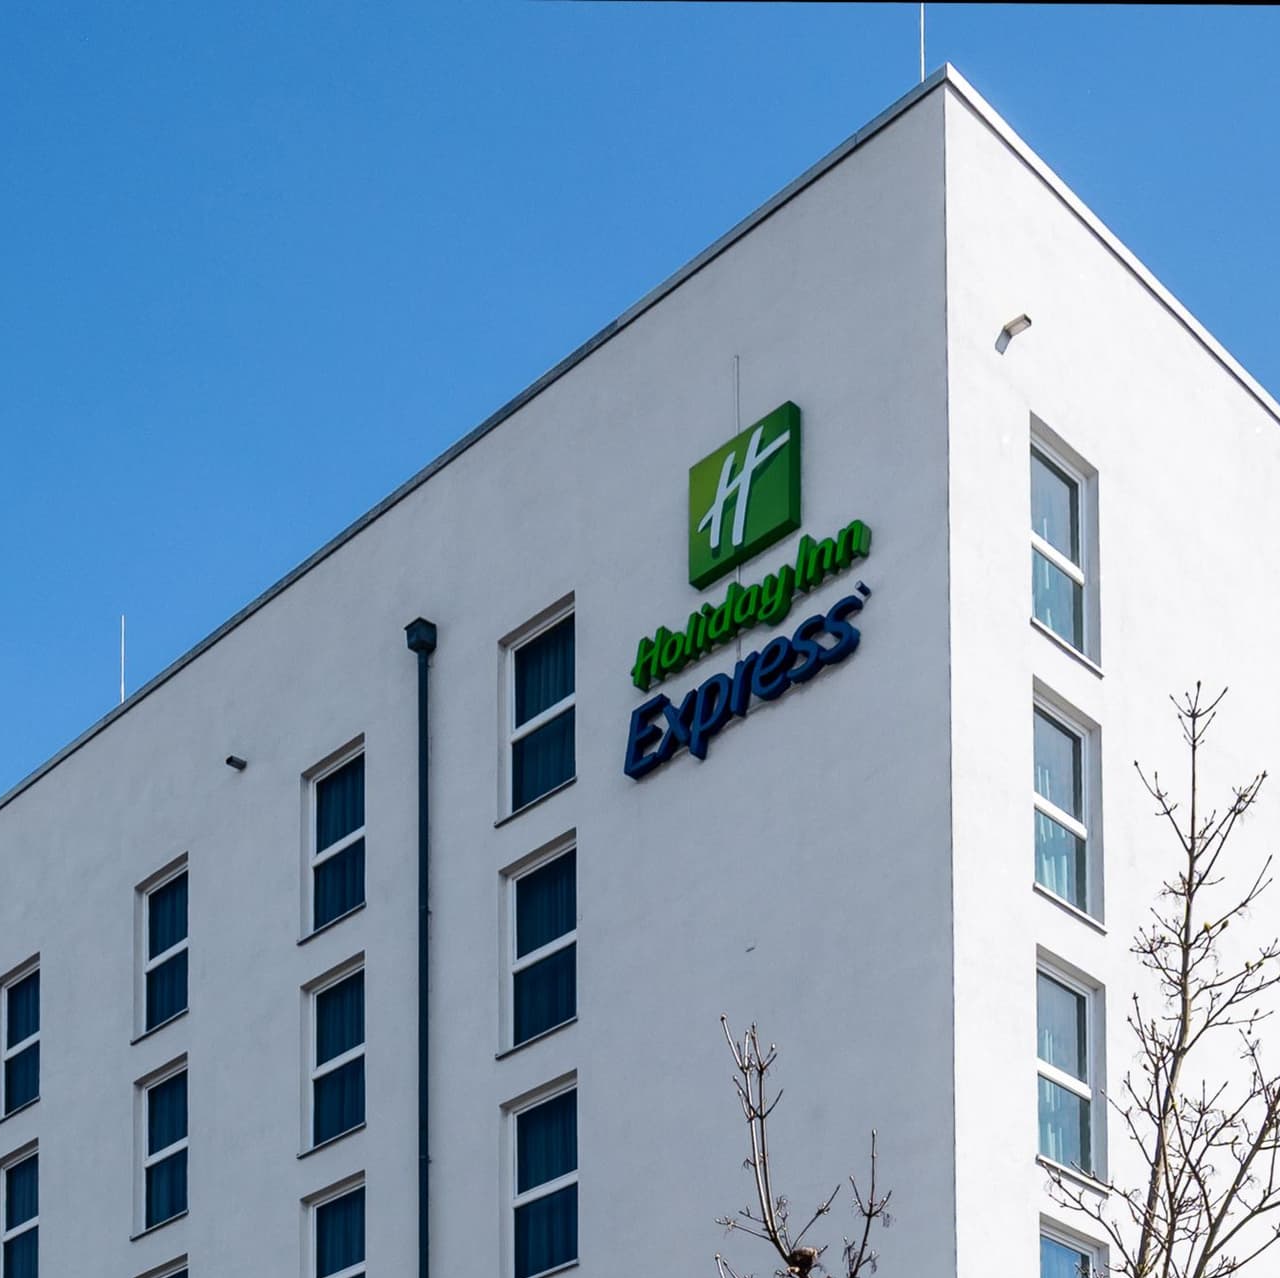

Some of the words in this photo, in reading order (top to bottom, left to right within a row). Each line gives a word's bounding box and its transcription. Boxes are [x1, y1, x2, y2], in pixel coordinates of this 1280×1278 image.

[624, 594, 864, 780] Express
[631, 565, 796, 692] Holiday
[794, 520, 873, 592] Inn
